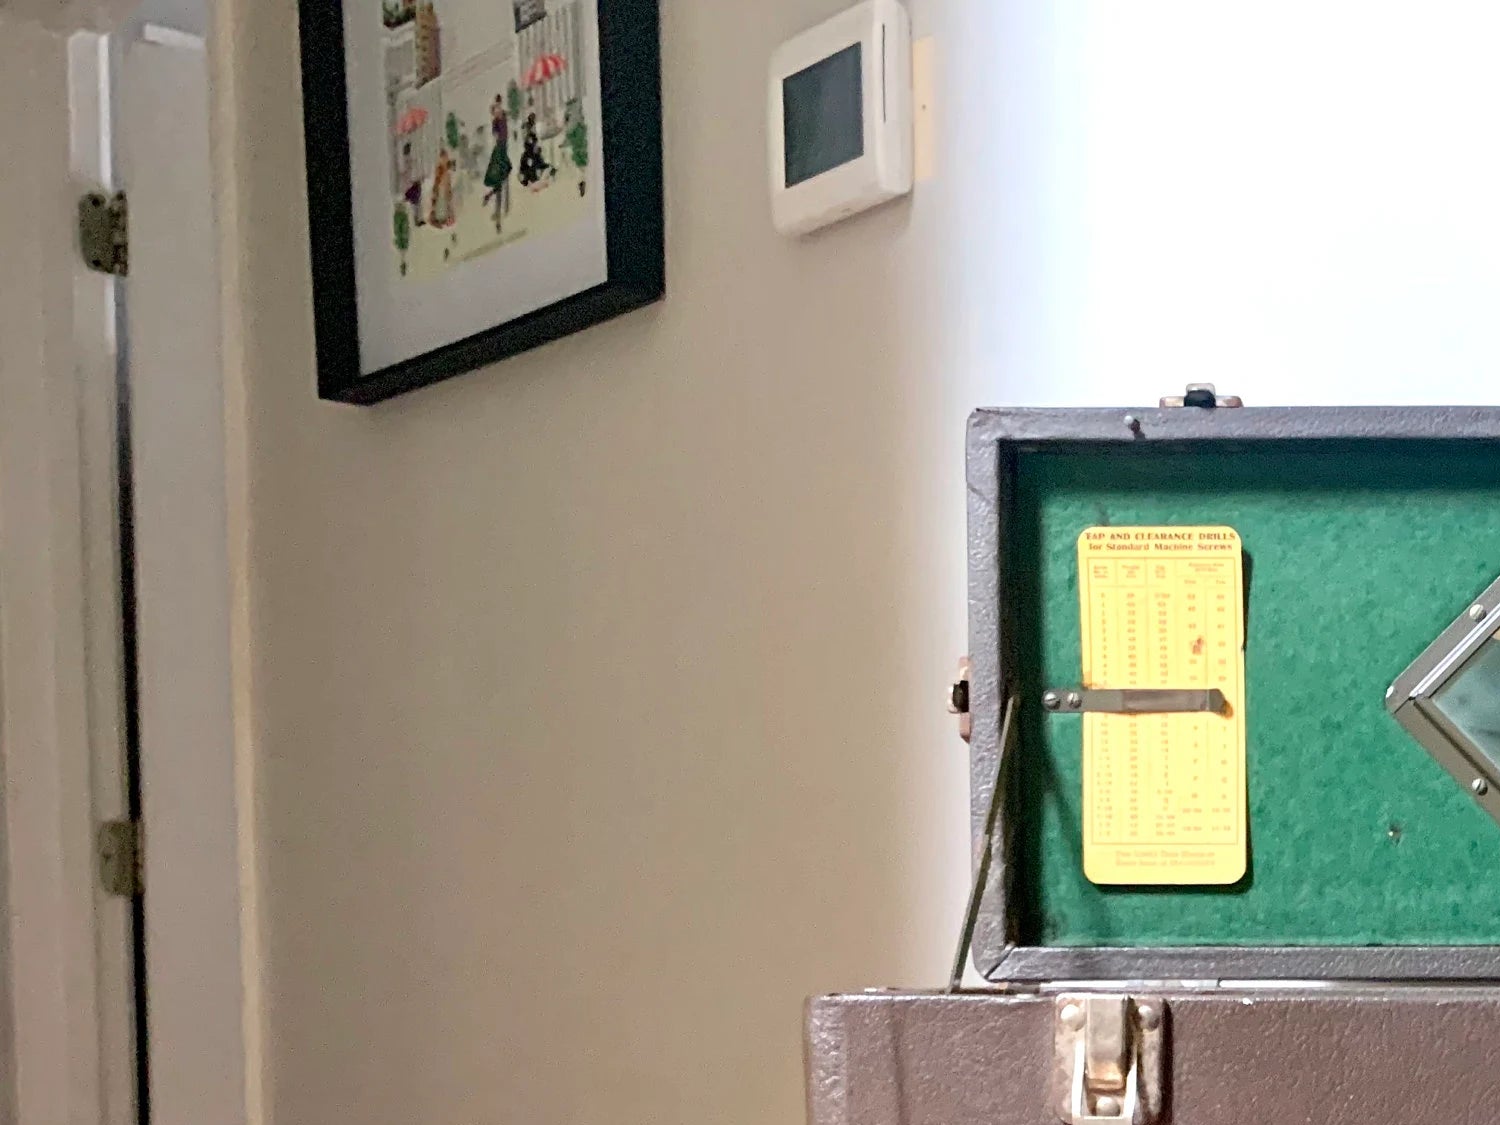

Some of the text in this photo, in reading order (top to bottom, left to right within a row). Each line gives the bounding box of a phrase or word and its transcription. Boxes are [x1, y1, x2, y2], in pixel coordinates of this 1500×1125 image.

[1110, 532, 1131, 541] AND
[1135, 532, 1193, 541] CLEARANCE
[1198, 532, 1236, 541] DRILLS
[1106, 543, 1150, 551] Standard
[1154, 543, 1193, 551] Machine
[1197, 543, 1233, 551] Screws
